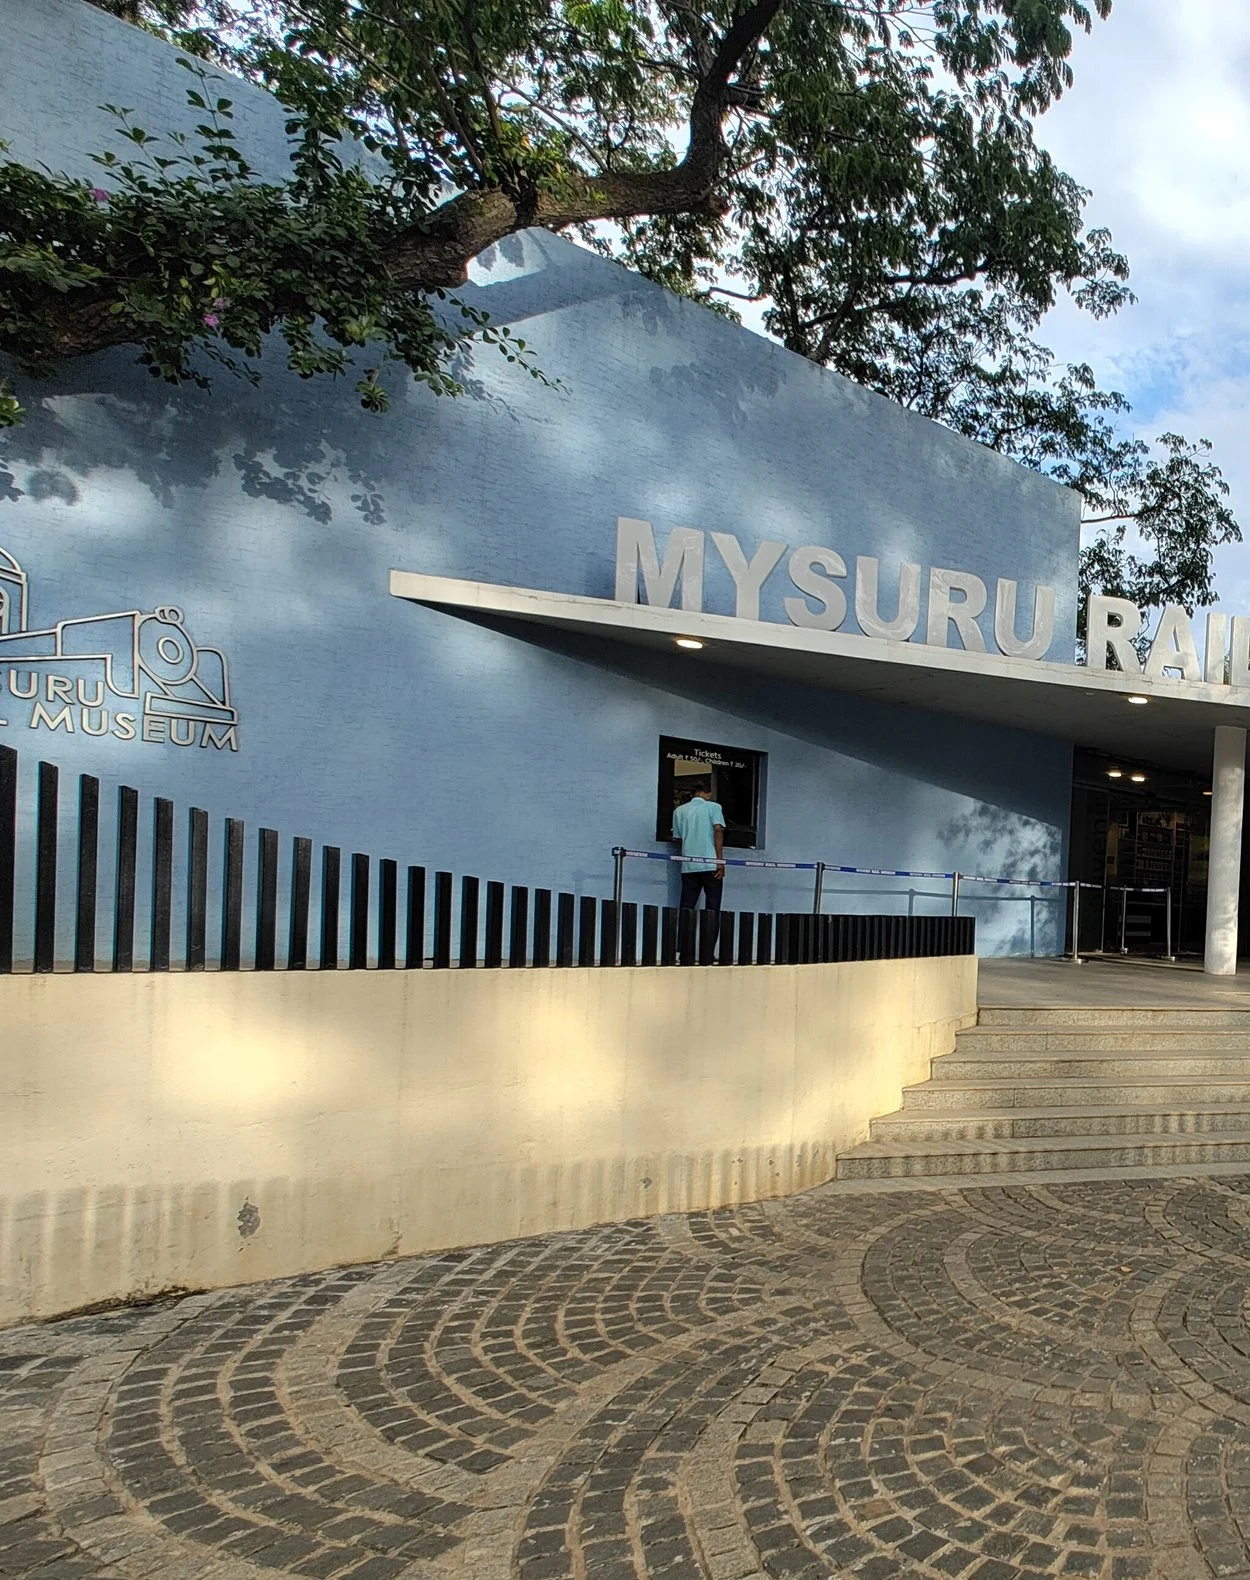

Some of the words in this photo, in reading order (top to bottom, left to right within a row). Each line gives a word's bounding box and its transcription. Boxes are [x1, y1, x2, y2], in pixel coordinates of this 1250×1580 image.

[614, 516, 1056, 660] MYSURU
[0, 668, 105, 708] URU
[29, 701, 239, 753] MUSEUM
[694, 748, 722, 760] Tickets
[705, 757, 729, 766] Children
